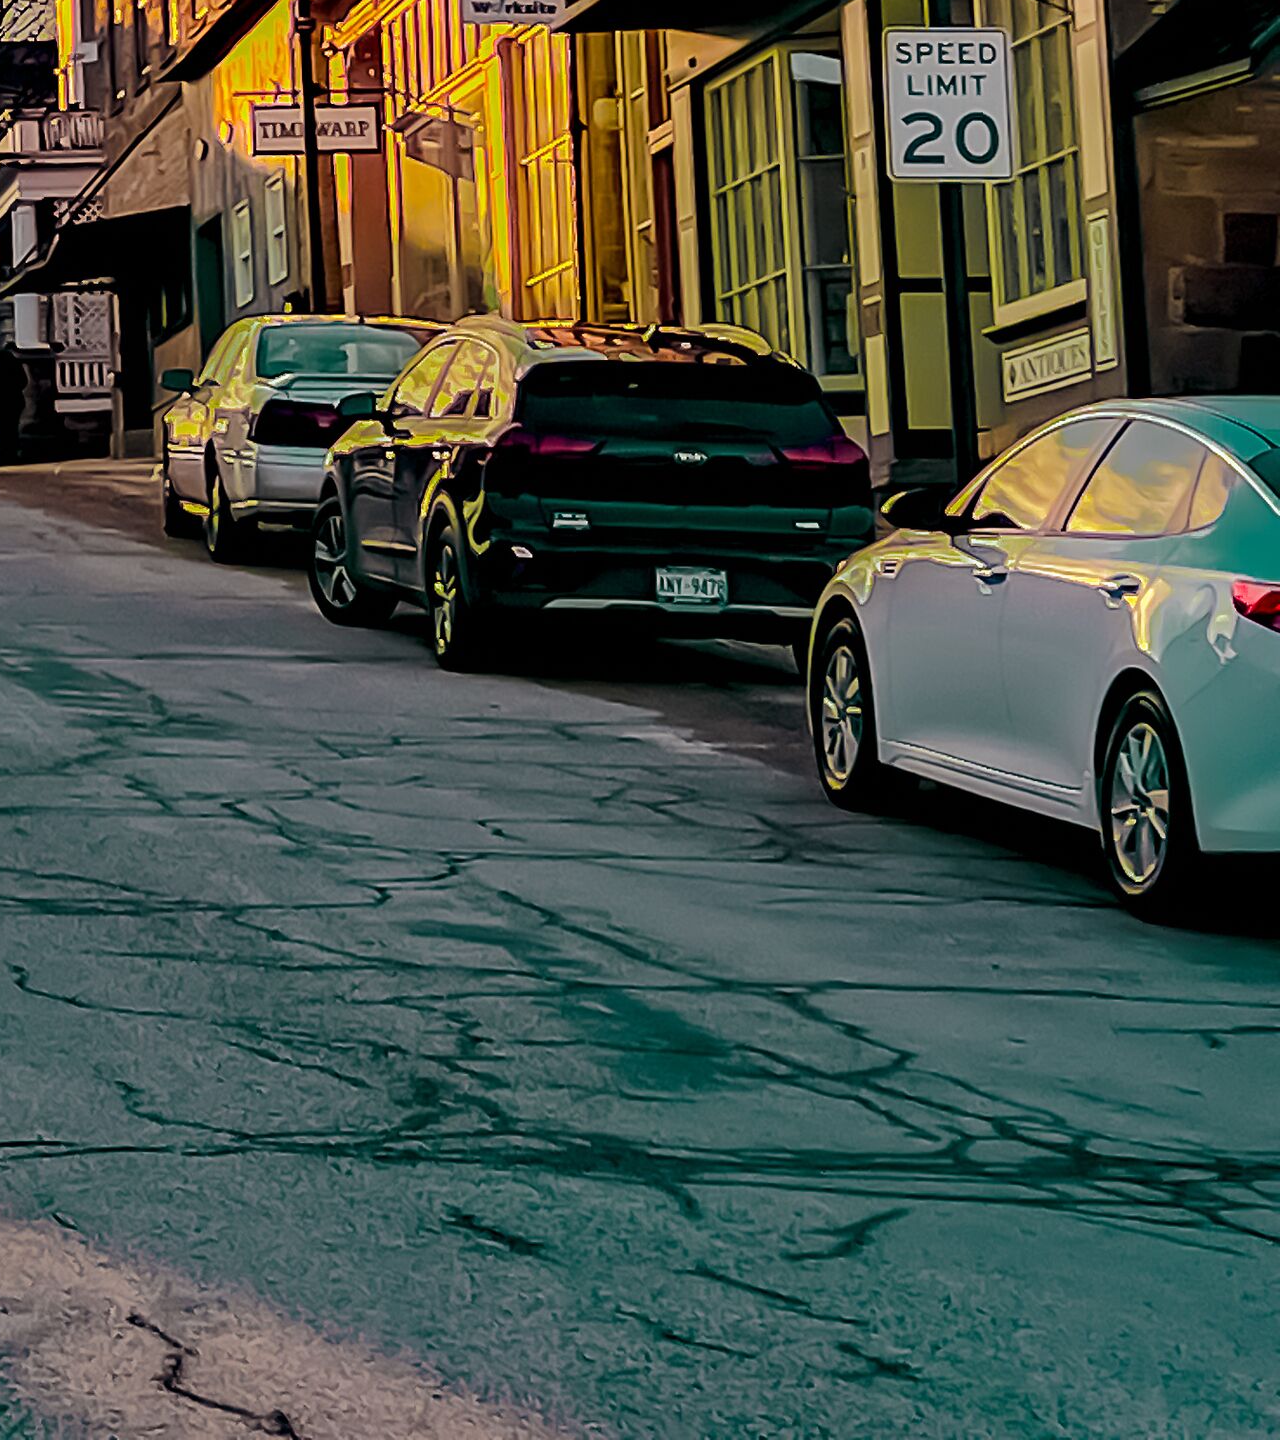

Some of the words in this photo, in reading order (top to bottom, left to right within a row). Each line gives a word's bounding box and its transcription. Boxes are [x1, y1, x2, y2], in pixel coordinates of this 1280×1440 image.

[895, 42, 997, 65] SPEED
[907, 74, 987, 96] LIMIT
[316, 120, 370, 138] WARP
[901, 111, 1000, 165] 20
[1018, 343, 1087, 385] ANTIQUES
